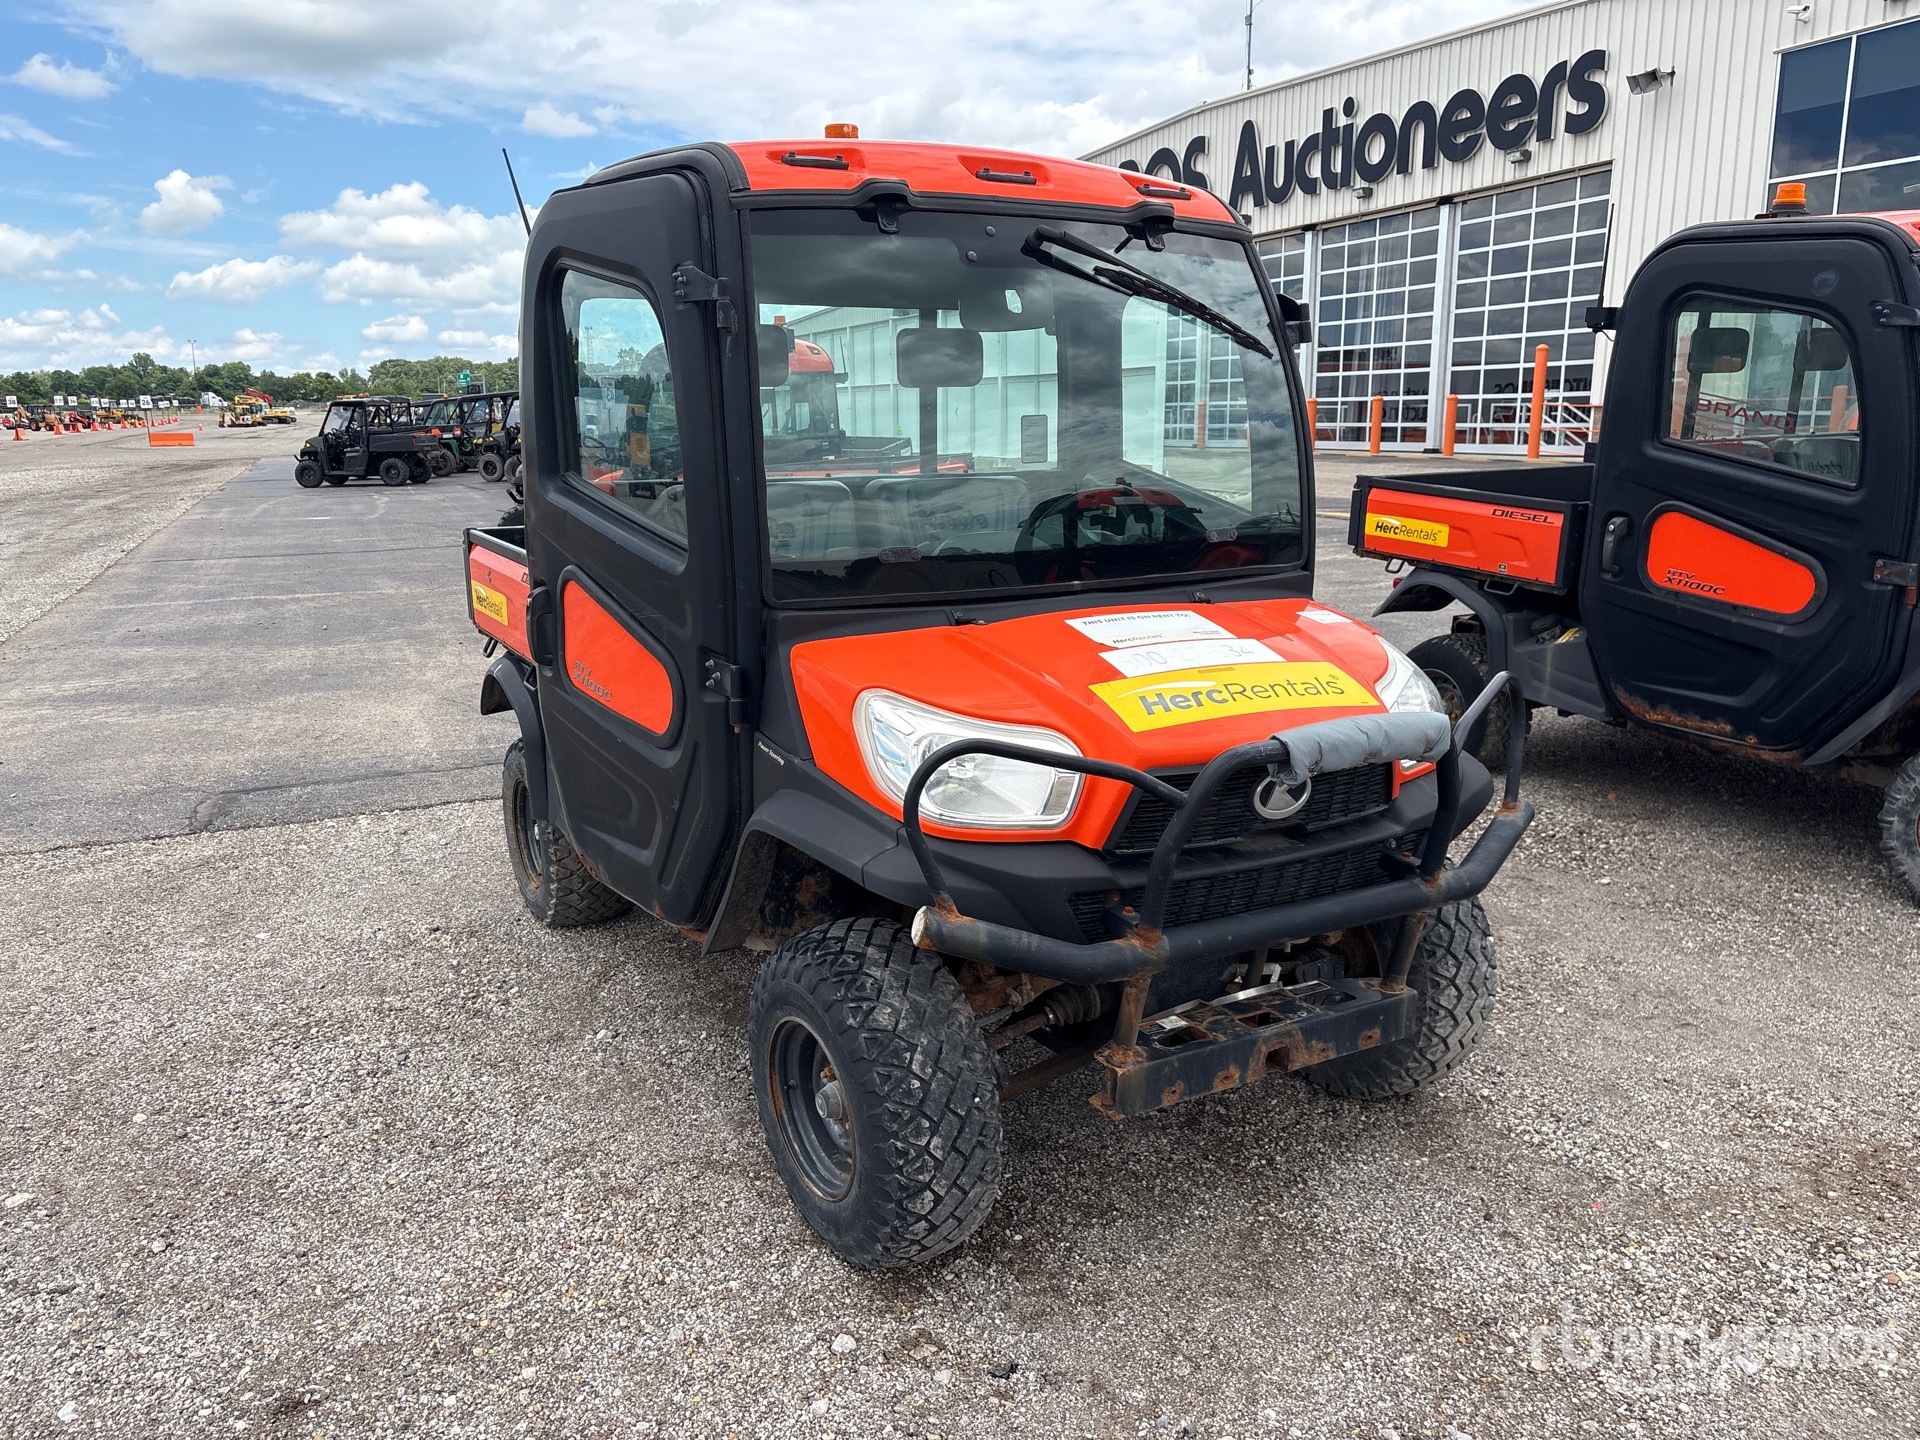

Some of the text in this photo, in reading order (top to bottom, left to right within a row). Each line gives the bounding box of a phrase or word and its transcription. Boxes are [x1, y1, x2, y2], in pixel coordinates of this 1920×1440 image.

[1229, 49, 1608, 212] Auctioneers
[1694, 397, 1796, 432] BRAND
[1492, 508, 1555, 525] DIESEL
[1374, 521, 1438, 542] HercRentals
[1667, 569, 1695, 579] RTV
[1664, 576, 1726, 595] X1100C
[474, 588, 504, 619] HercRentals
[1112, 633, 1164, 645] HercRentals
[574, 661, 593, 677] RTV
[1138, 676, 1345, 716] HercRentals
[757, 740, 785, 766] Power Steering
